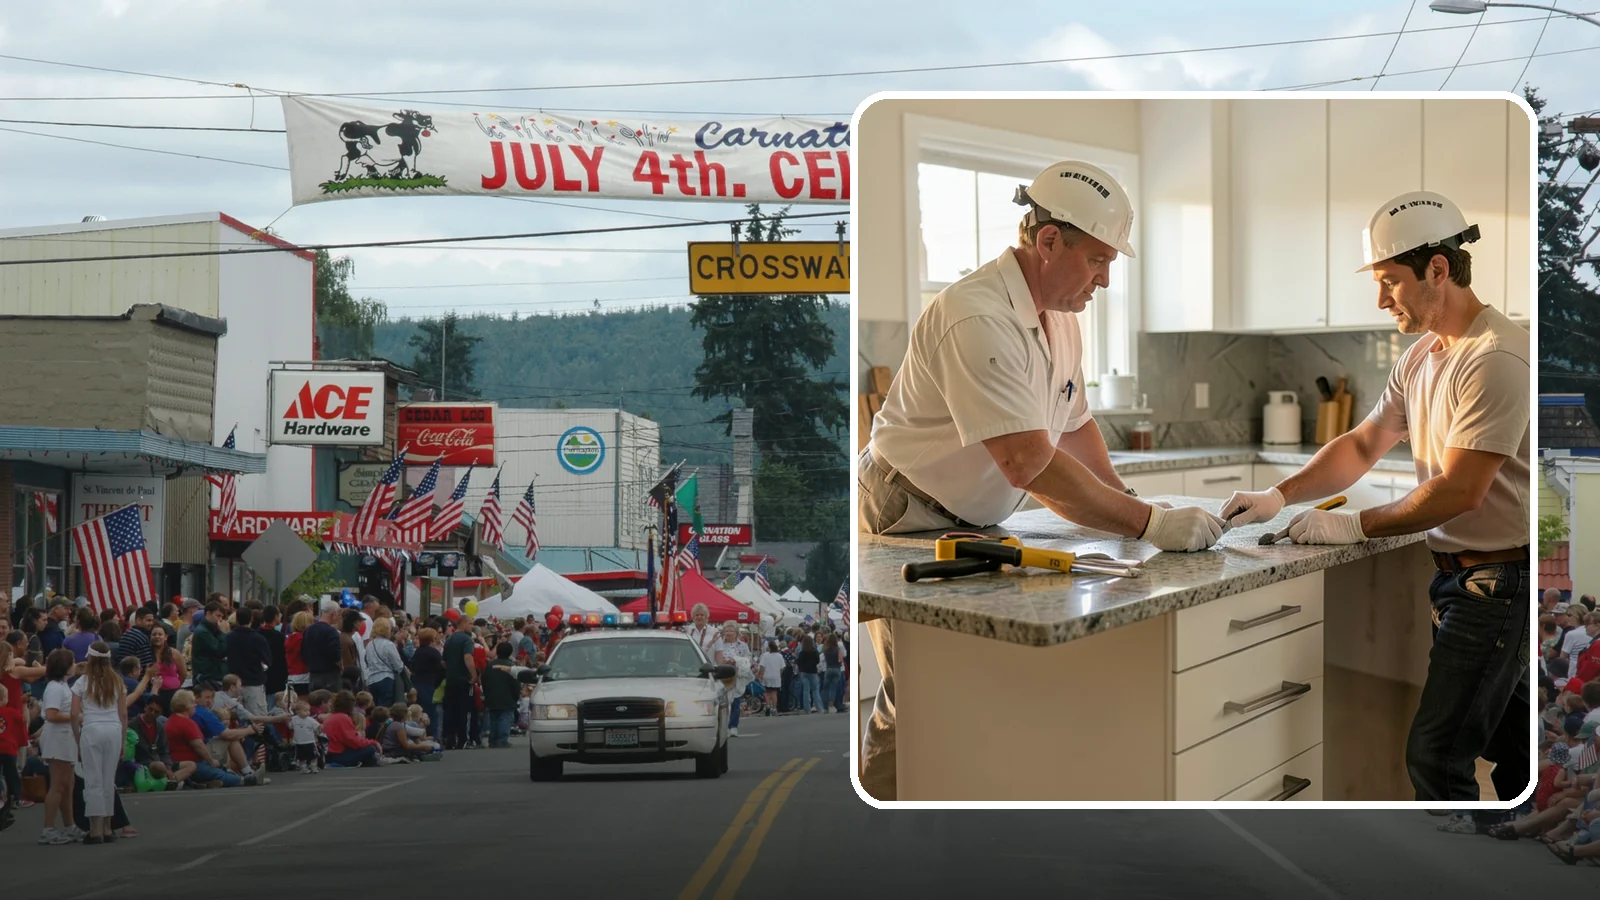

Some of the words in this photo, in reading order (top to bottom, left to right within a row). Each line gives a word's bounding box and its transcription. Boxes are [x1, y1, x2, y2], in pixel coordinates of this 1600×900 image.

[481, 141, 605, 192] JULY
[632, 150, 746, 197] 4th.
[697, 254, 850, 280] CROSSWA
[283, 380, 373, 419] ACE
[405, 410, 452, 421] CEDAR
[283, 421, 371, 436] Hardware
[353, 467, 384, 481] Simpl
[95, 485, 124, 494] Vincent
[126, 486, 135, 494] de
[137, 486, 155, 495] Paul
[688, 526, 741, 535] CRNATION
[699, 535, 730, 543] GLASS
